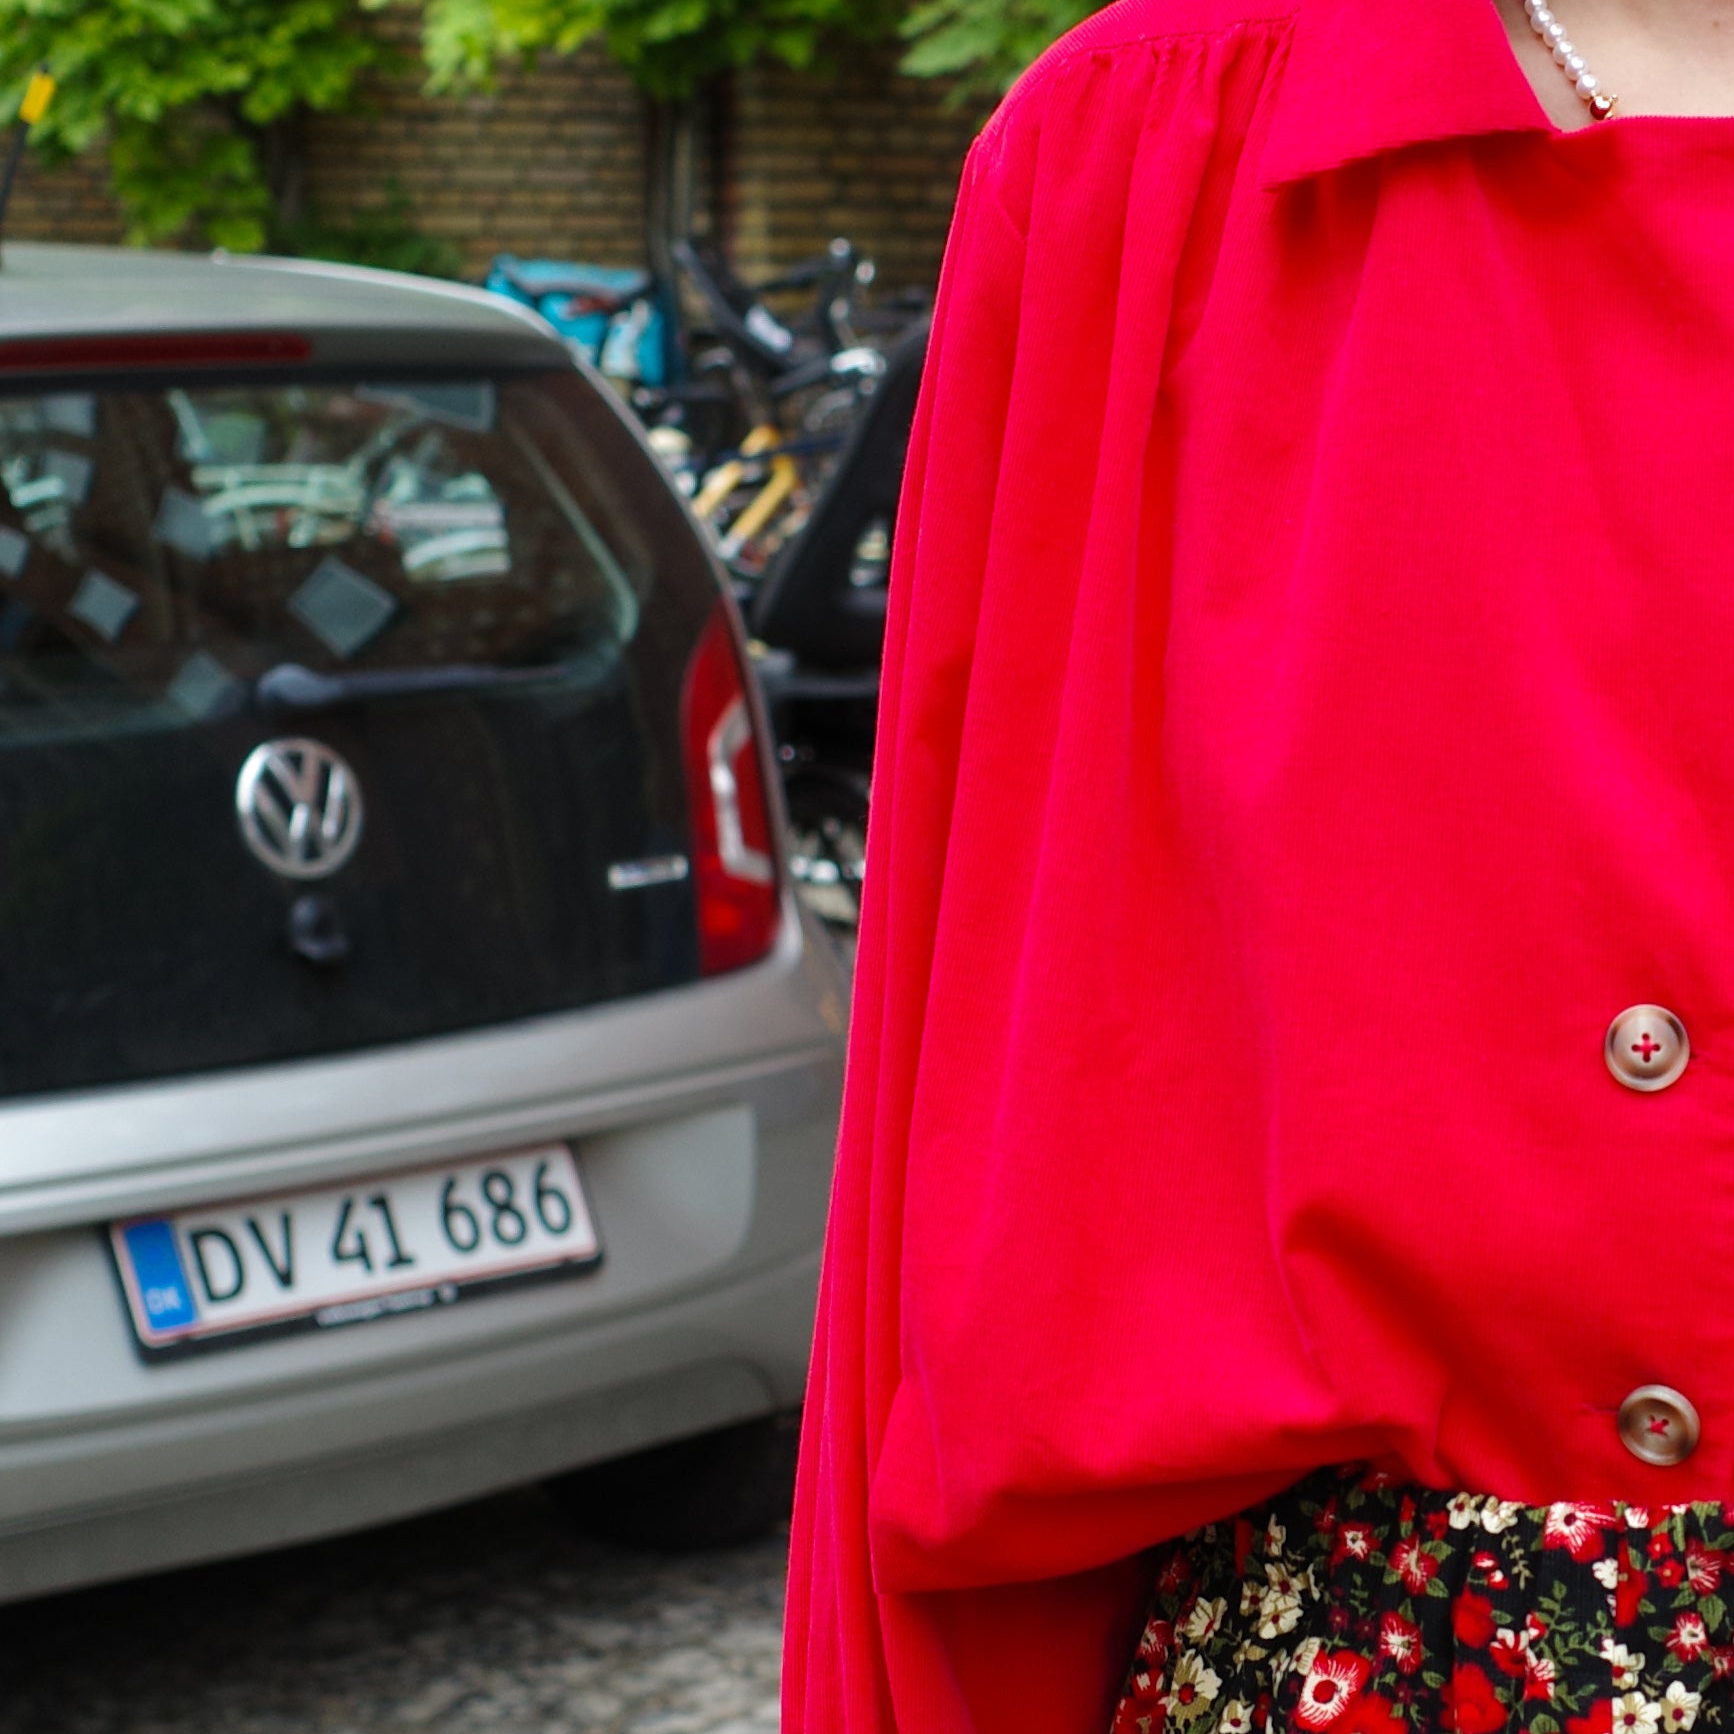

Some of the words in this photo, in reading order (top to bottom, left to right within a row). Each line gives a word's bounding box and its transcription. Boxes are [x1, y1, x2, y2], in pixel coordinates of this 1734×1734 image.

[188, 1209, 294, 1303] DV
[331, 1192, 415, 1274] 41
[440, 1161, 573, 1254] 686
